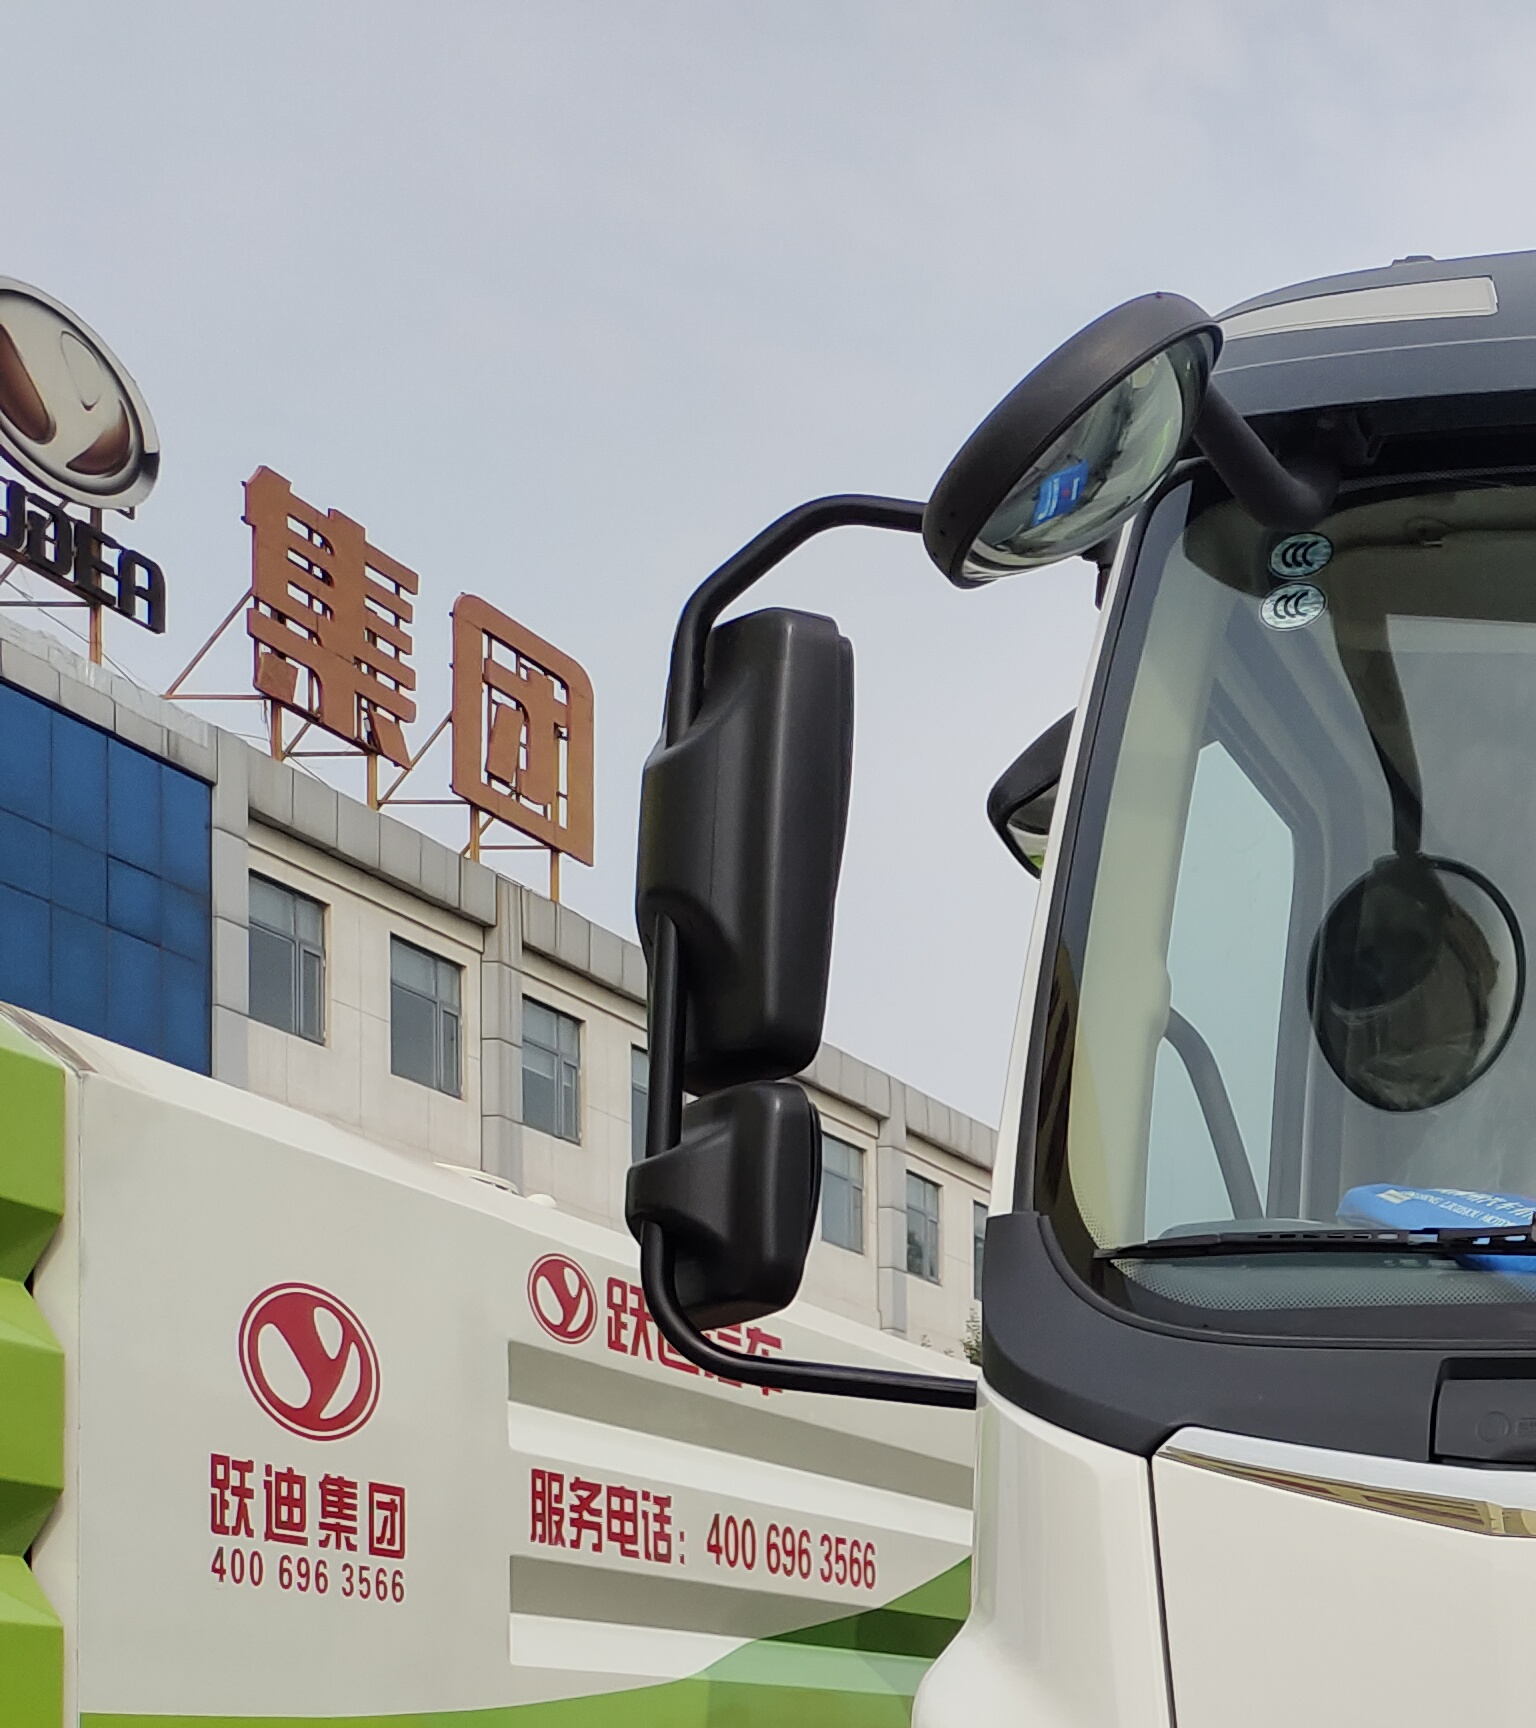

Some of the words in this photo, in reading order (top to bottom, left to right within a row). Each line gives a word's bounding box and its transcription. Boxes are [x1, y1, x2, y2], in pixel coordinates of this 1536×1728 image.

[245, 465, 594, 868] 集团
[210, 1453, 406, 1560] 跃迪集团
[706, 1513, 757, 1571] 400
[766, 1523, 812, 1580] 696
[820, 1534, 876, 1590] 3566
[211, 1546, 264, 1587] 400
[278, 1554, 328, 1595] 696
[341, 1562, 405, 1603] 3566
